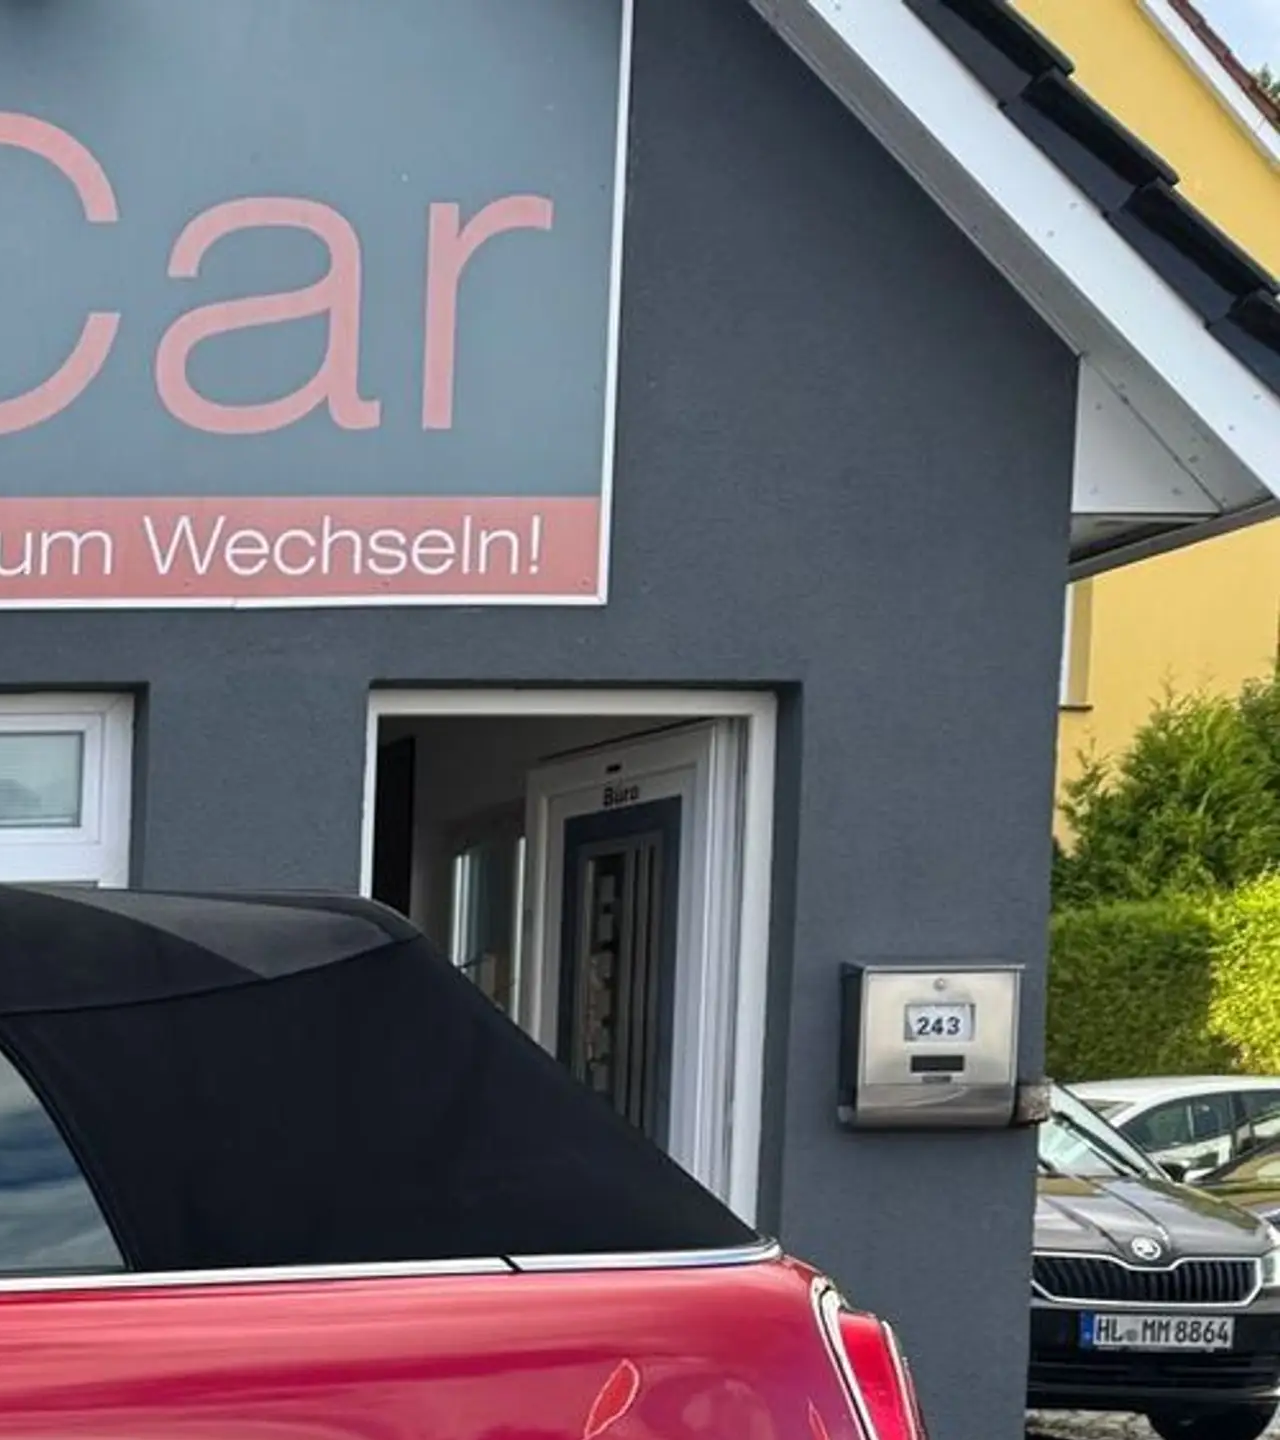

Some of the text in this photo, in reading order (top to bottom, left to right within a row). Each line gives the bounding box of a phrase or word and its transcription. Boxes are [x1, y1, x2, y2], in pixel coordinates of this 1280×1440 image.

[143, 514, 541, 578] Wechseln!
[916, 1015, 961, 1037] 243
[1097, 1318, 1230, 1344] HL MM 8864
